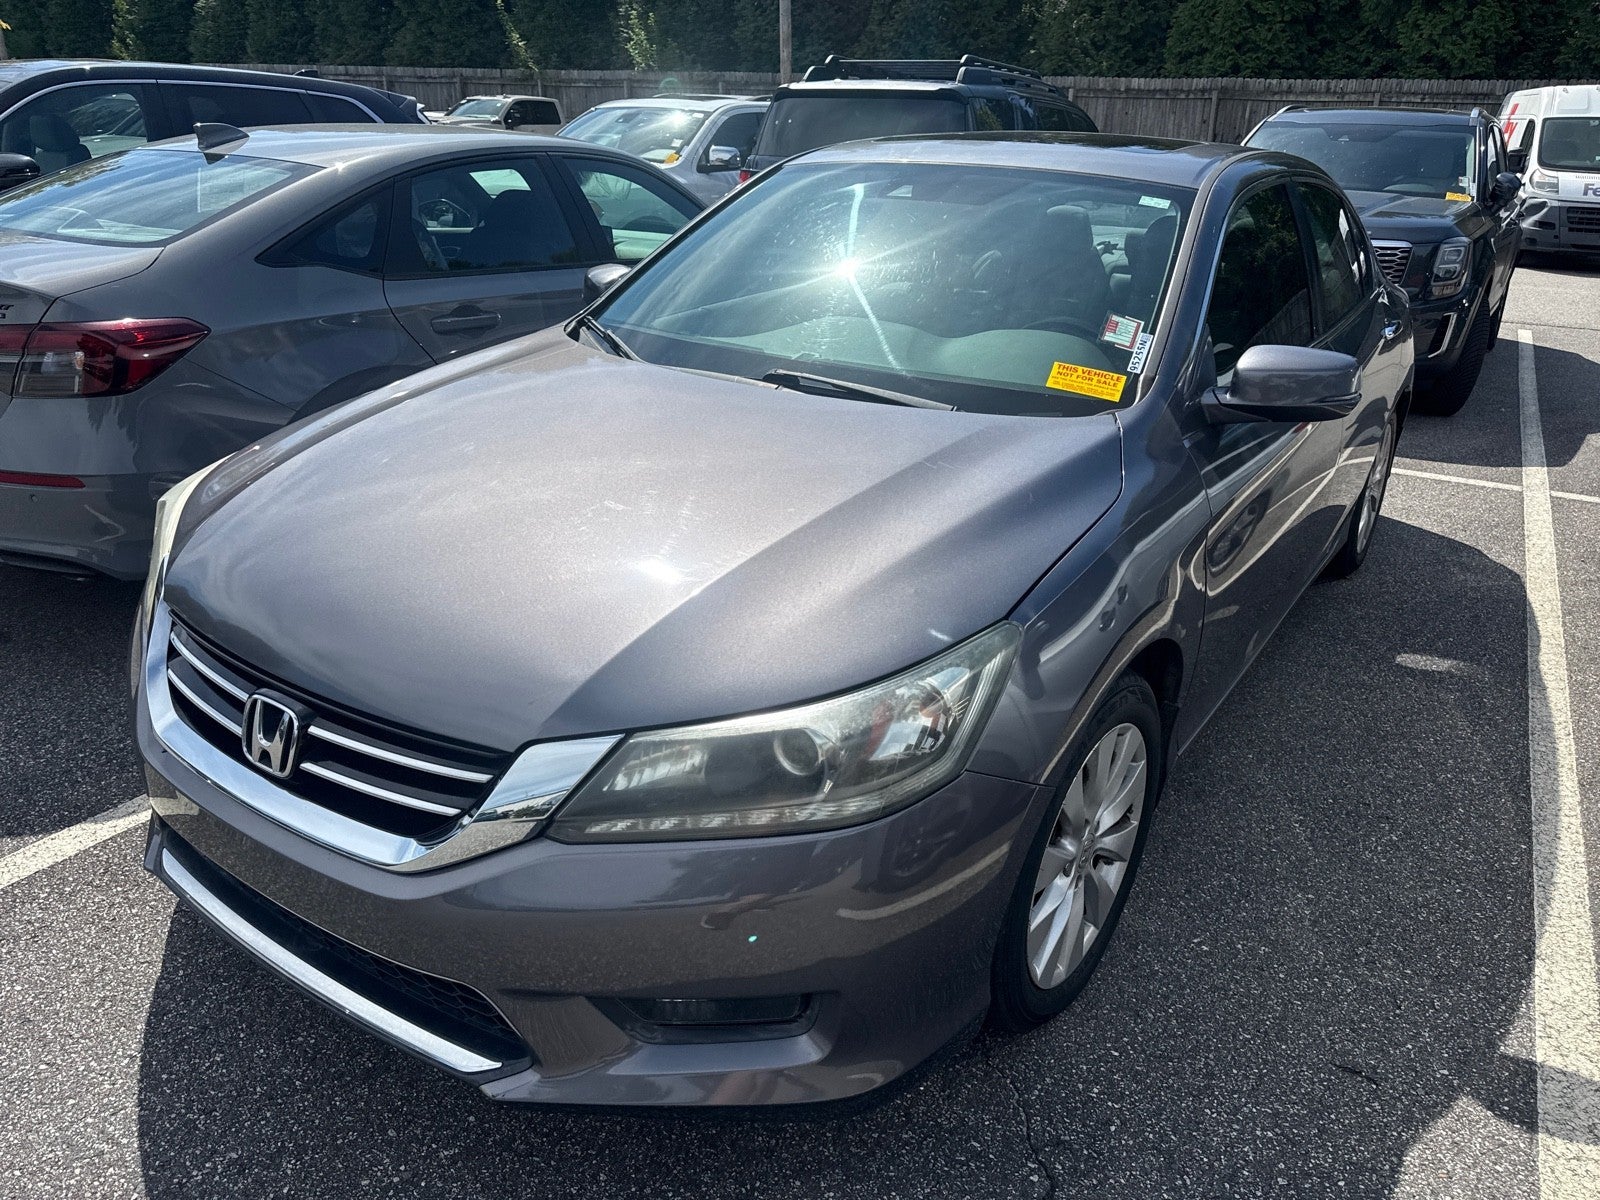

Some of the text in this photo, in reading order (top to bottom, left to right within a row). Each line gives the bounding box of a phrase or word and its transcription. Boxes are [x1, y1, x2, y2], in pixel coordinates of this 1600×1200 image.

[1057, 363, 1123, 383] THIS VEHICLE
[1076, 374, 1094, 382] FOR
[1096, 379, 1119, 388] SALE
